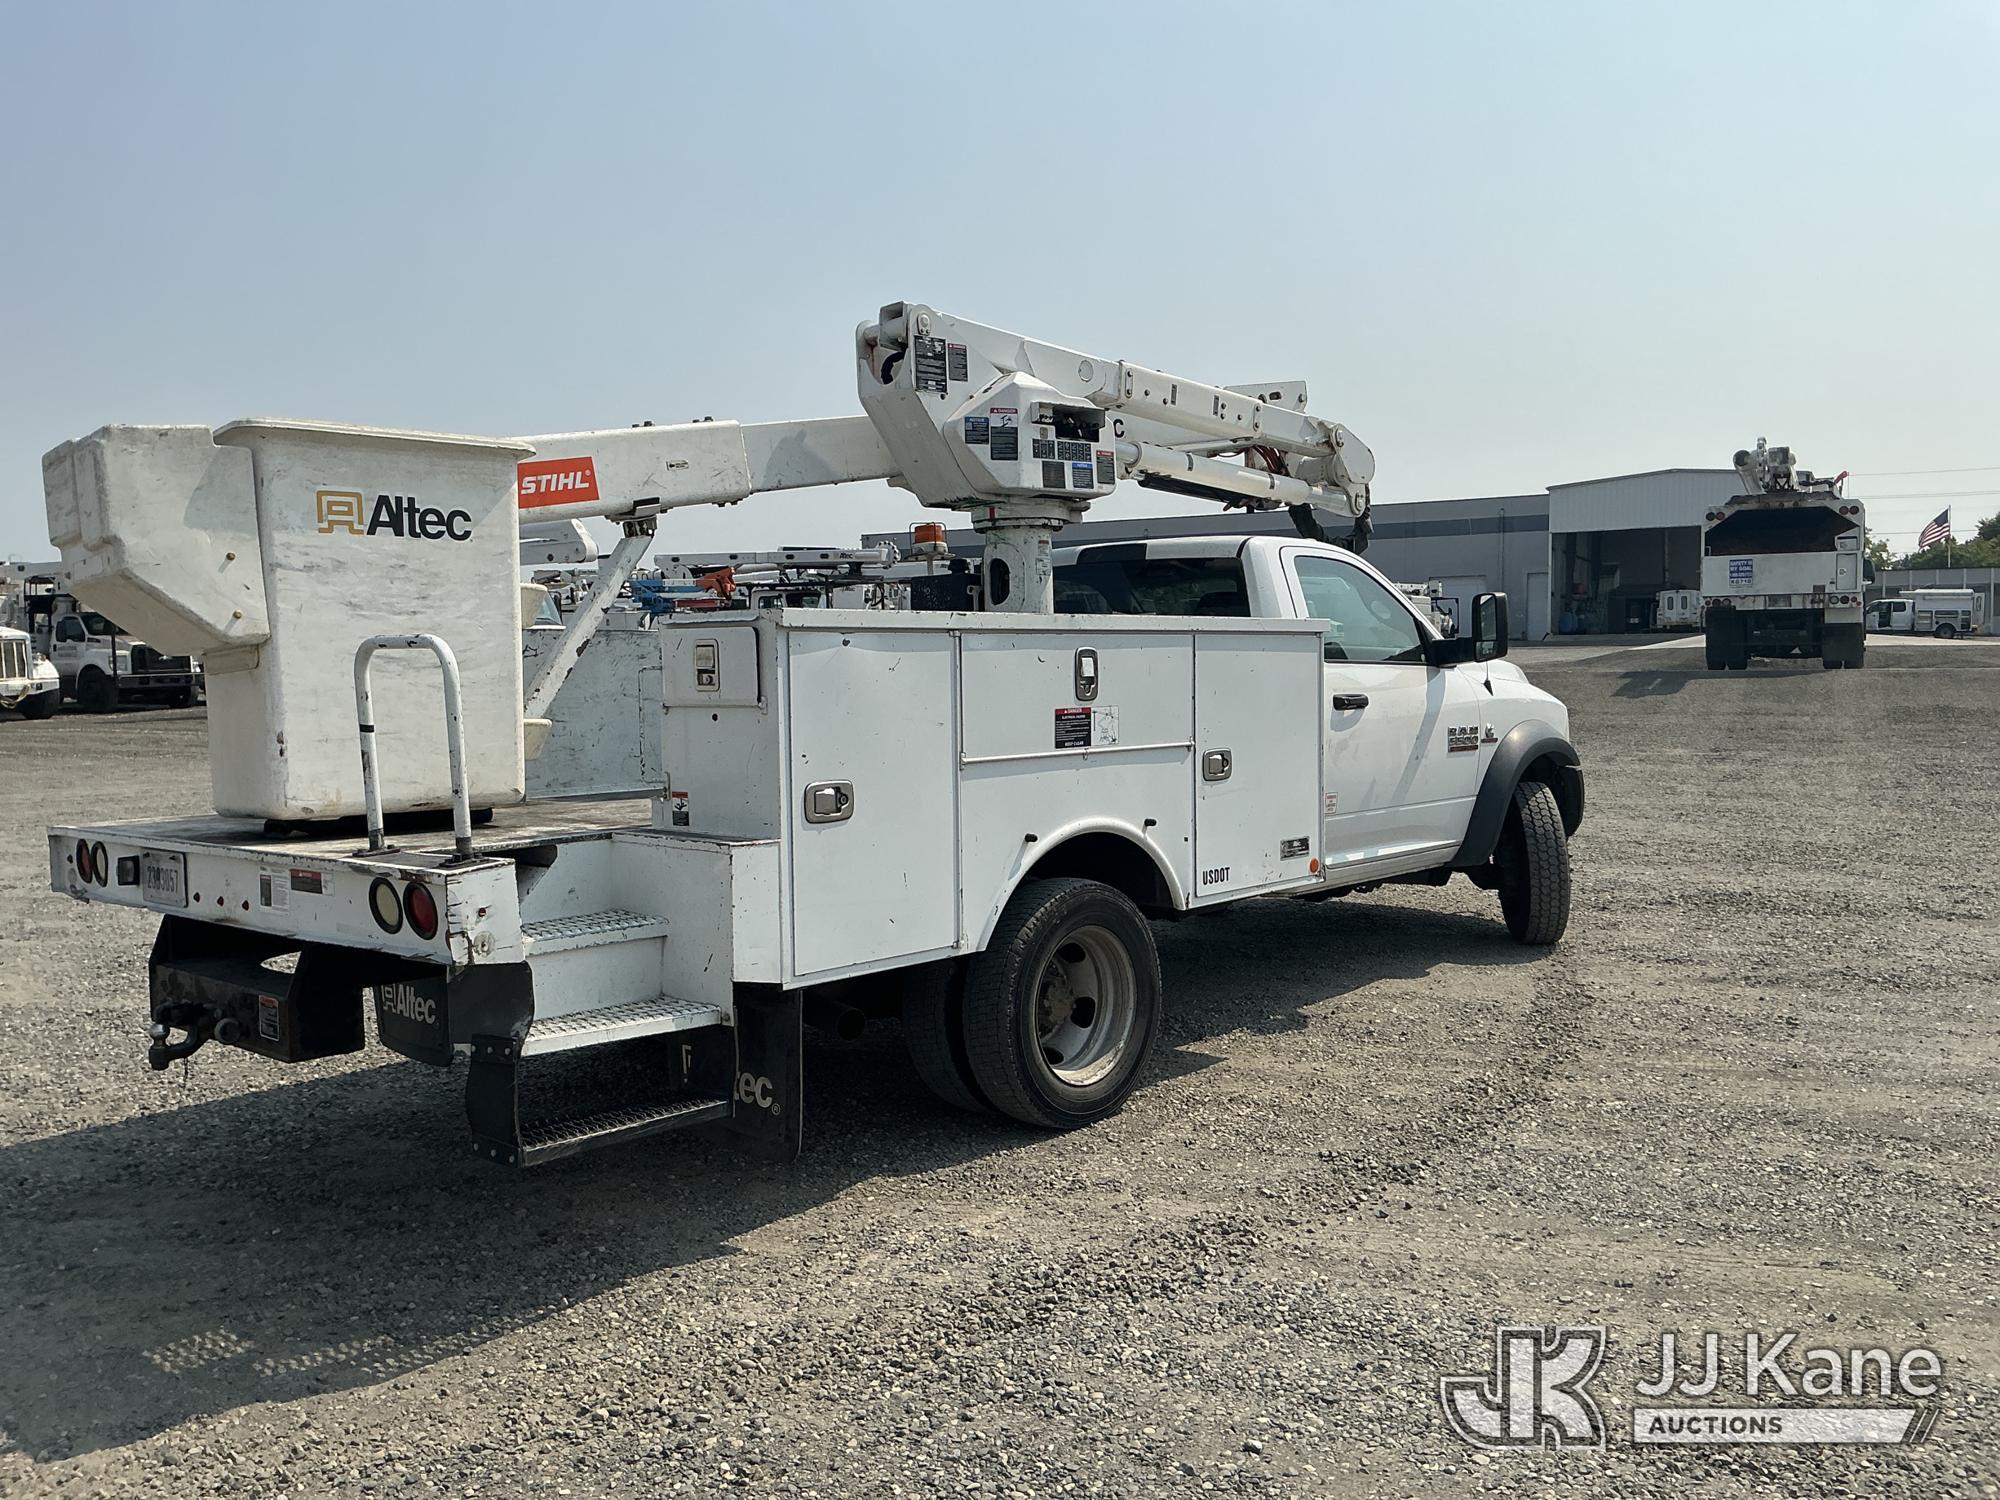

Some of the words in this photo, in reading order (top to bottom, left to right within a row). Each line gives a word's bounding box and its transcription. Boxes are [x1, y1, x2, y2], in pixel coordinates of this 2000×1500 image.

[520, 471, 590, 495] STIHL
[366, 494, 473, 541] Altec
[1448, 726, 1479, 736] RAM
[1202, 867, 1231, 886] USDOT
[397, 984, 436, 1025] Altec
